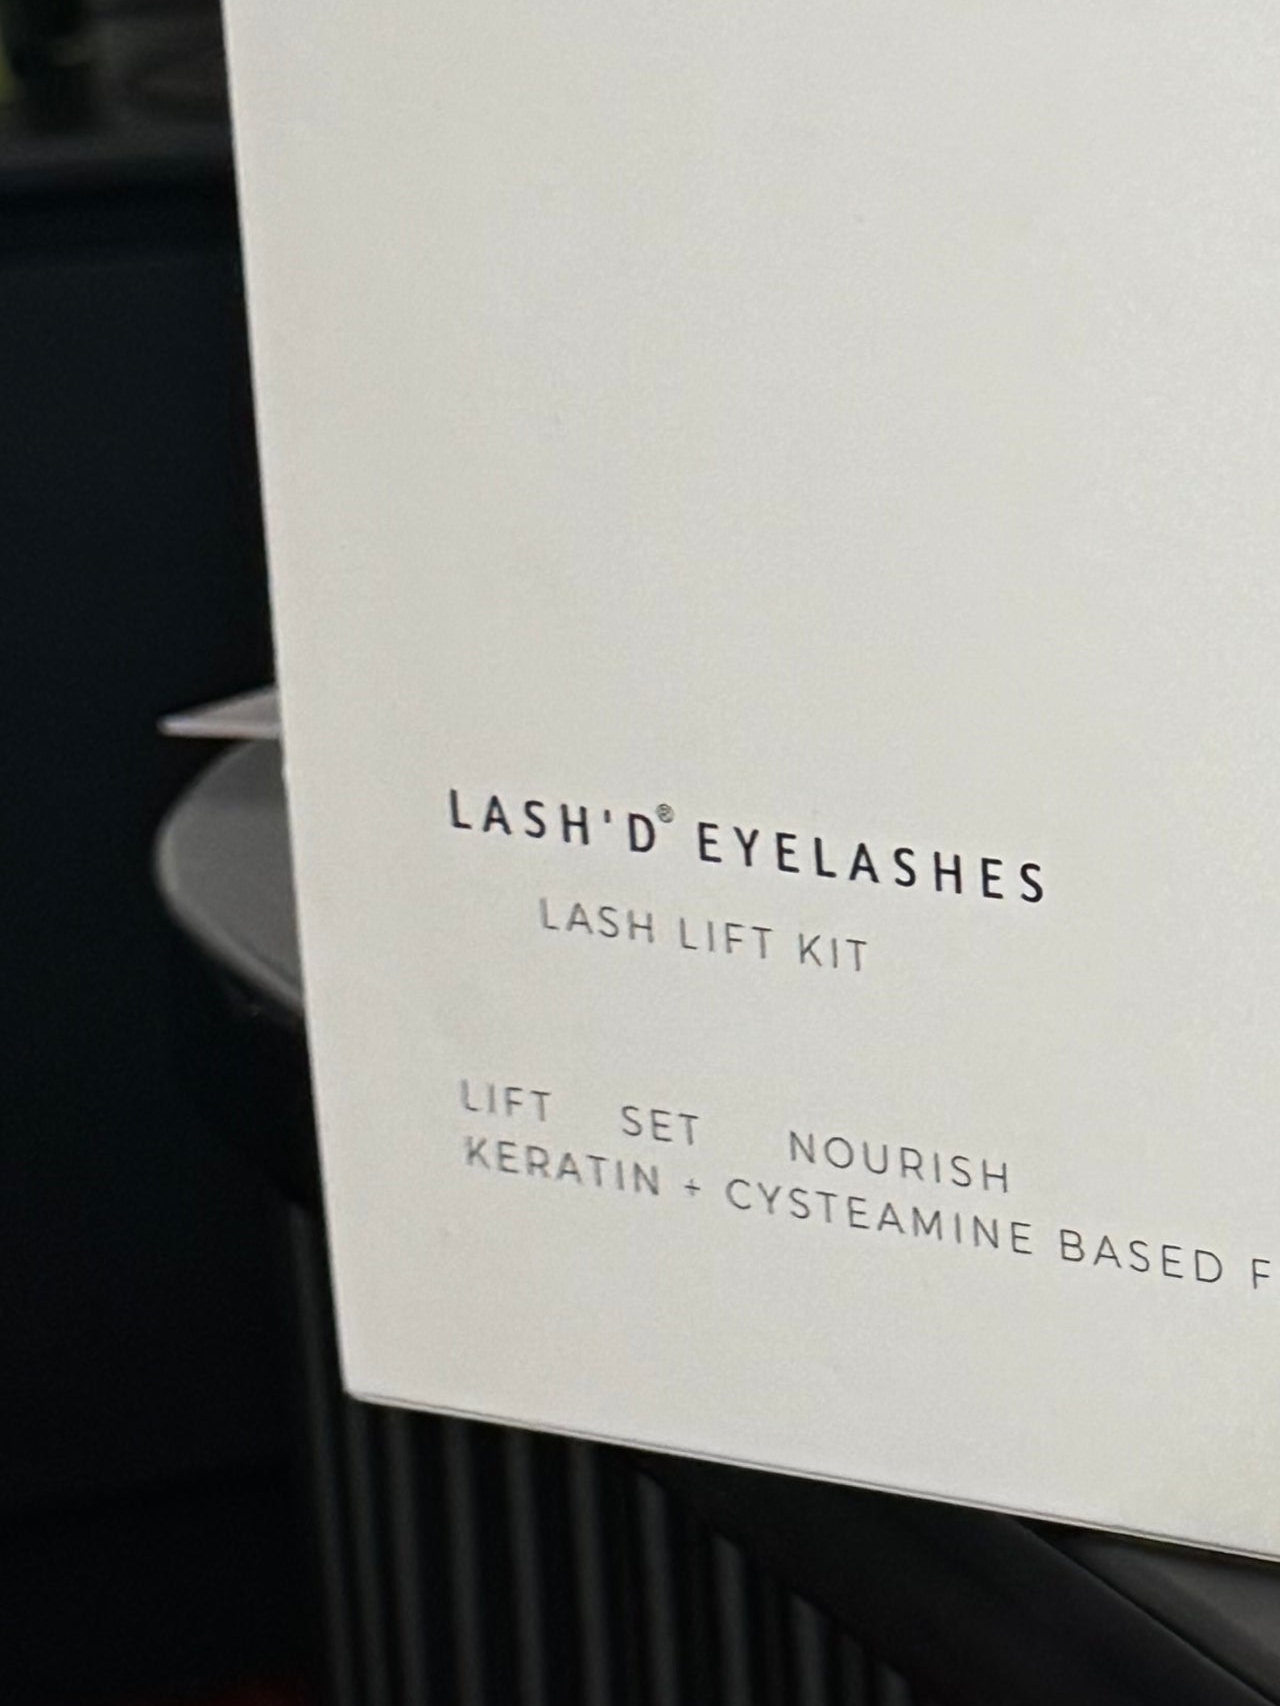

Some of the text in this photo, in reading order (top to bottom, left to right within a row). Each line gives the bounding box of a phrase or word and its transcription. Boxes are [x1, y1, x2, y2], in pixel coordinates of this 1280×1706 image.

[697, 821, 1046, 904] EYELASHES
[538, 896, 868, 973] LASH LIFT KIT
[460, 1078, 1010, 1194] LIFT SET NOURISH
[464, 1136, 660, 1196] KERATIN
[682, 1177, 704, 1200] +
[724, 1177, 1034, 1257] CYSTEAMINE
[1058, 1227, 1225, 1285] BASED
